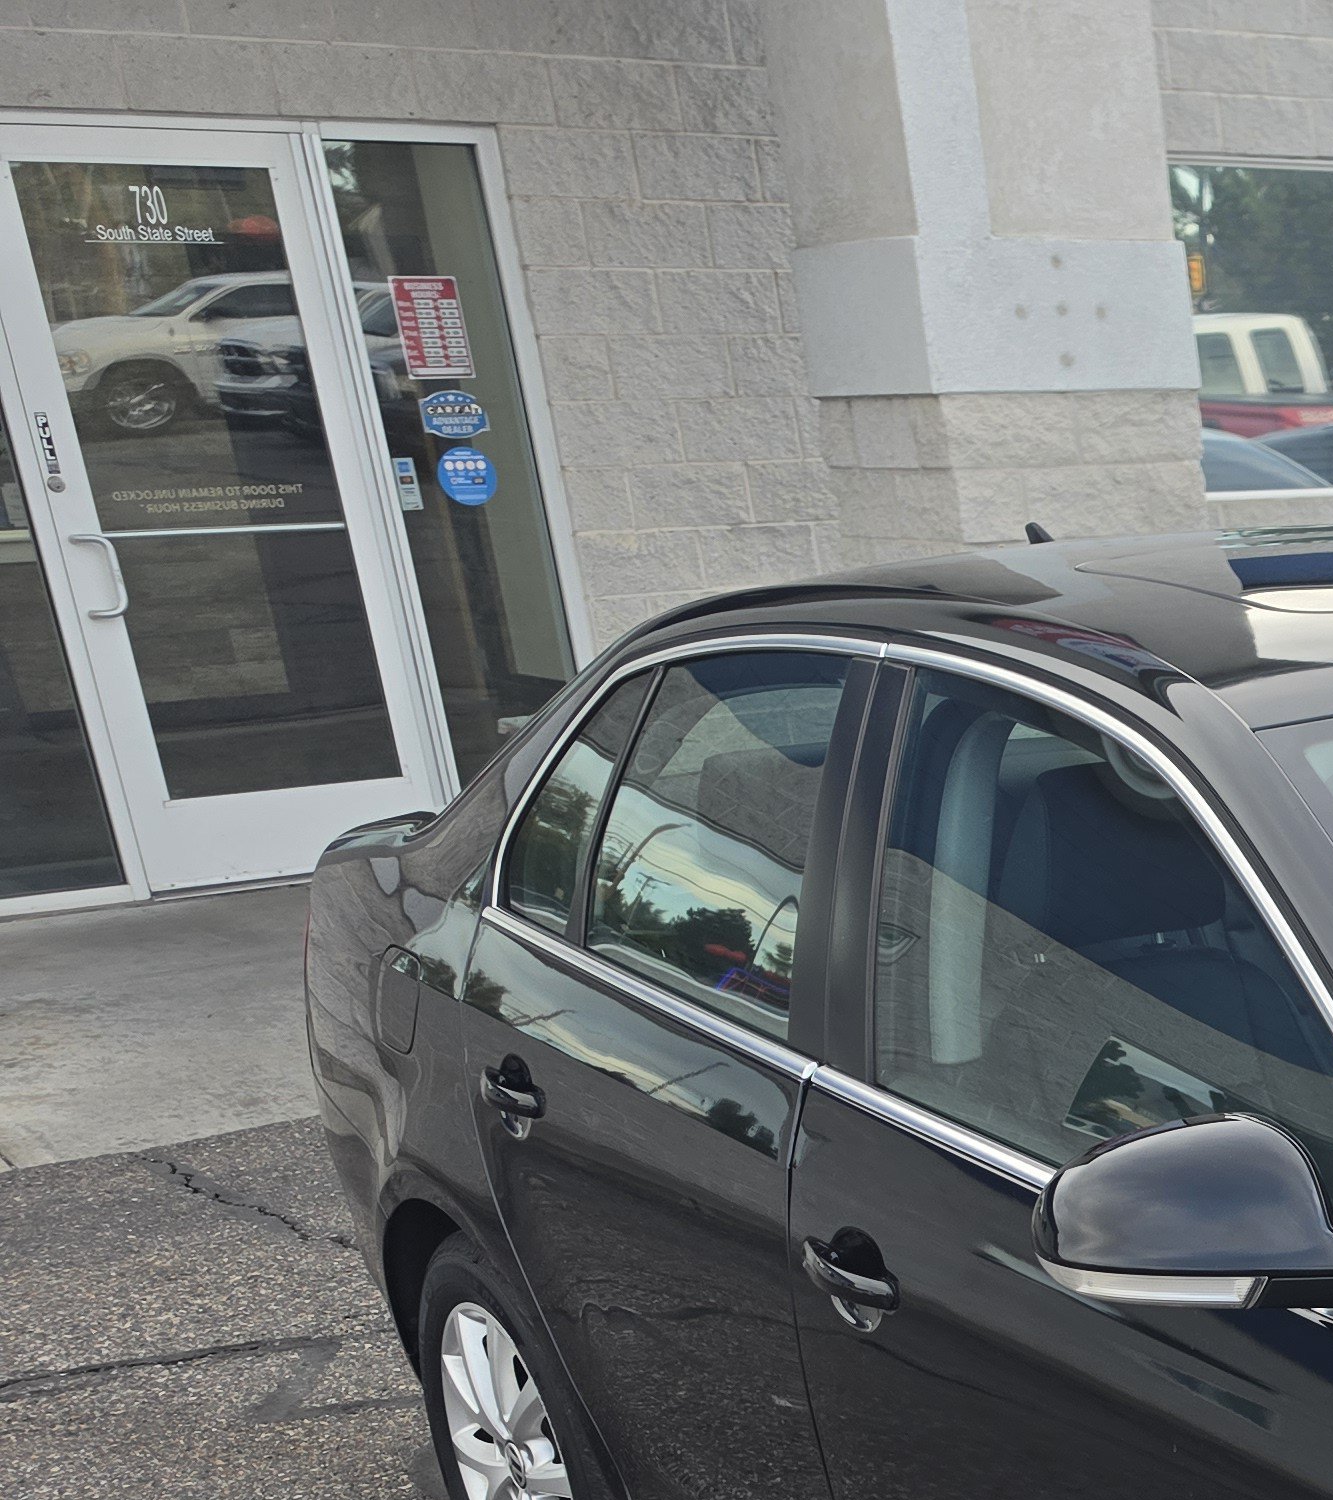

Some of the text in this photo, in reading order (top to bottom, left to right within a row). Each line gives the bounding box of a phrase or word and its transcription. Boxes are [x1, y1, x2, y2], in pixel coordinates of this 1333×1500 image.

[128, 185, 168, 225] 730
[95, 224, 216, 242] South State Street
[426, 403, 483, 415] CARFA
[36, 415, 57, 461] PULL
[441, 425, 475, 434] DEALER
